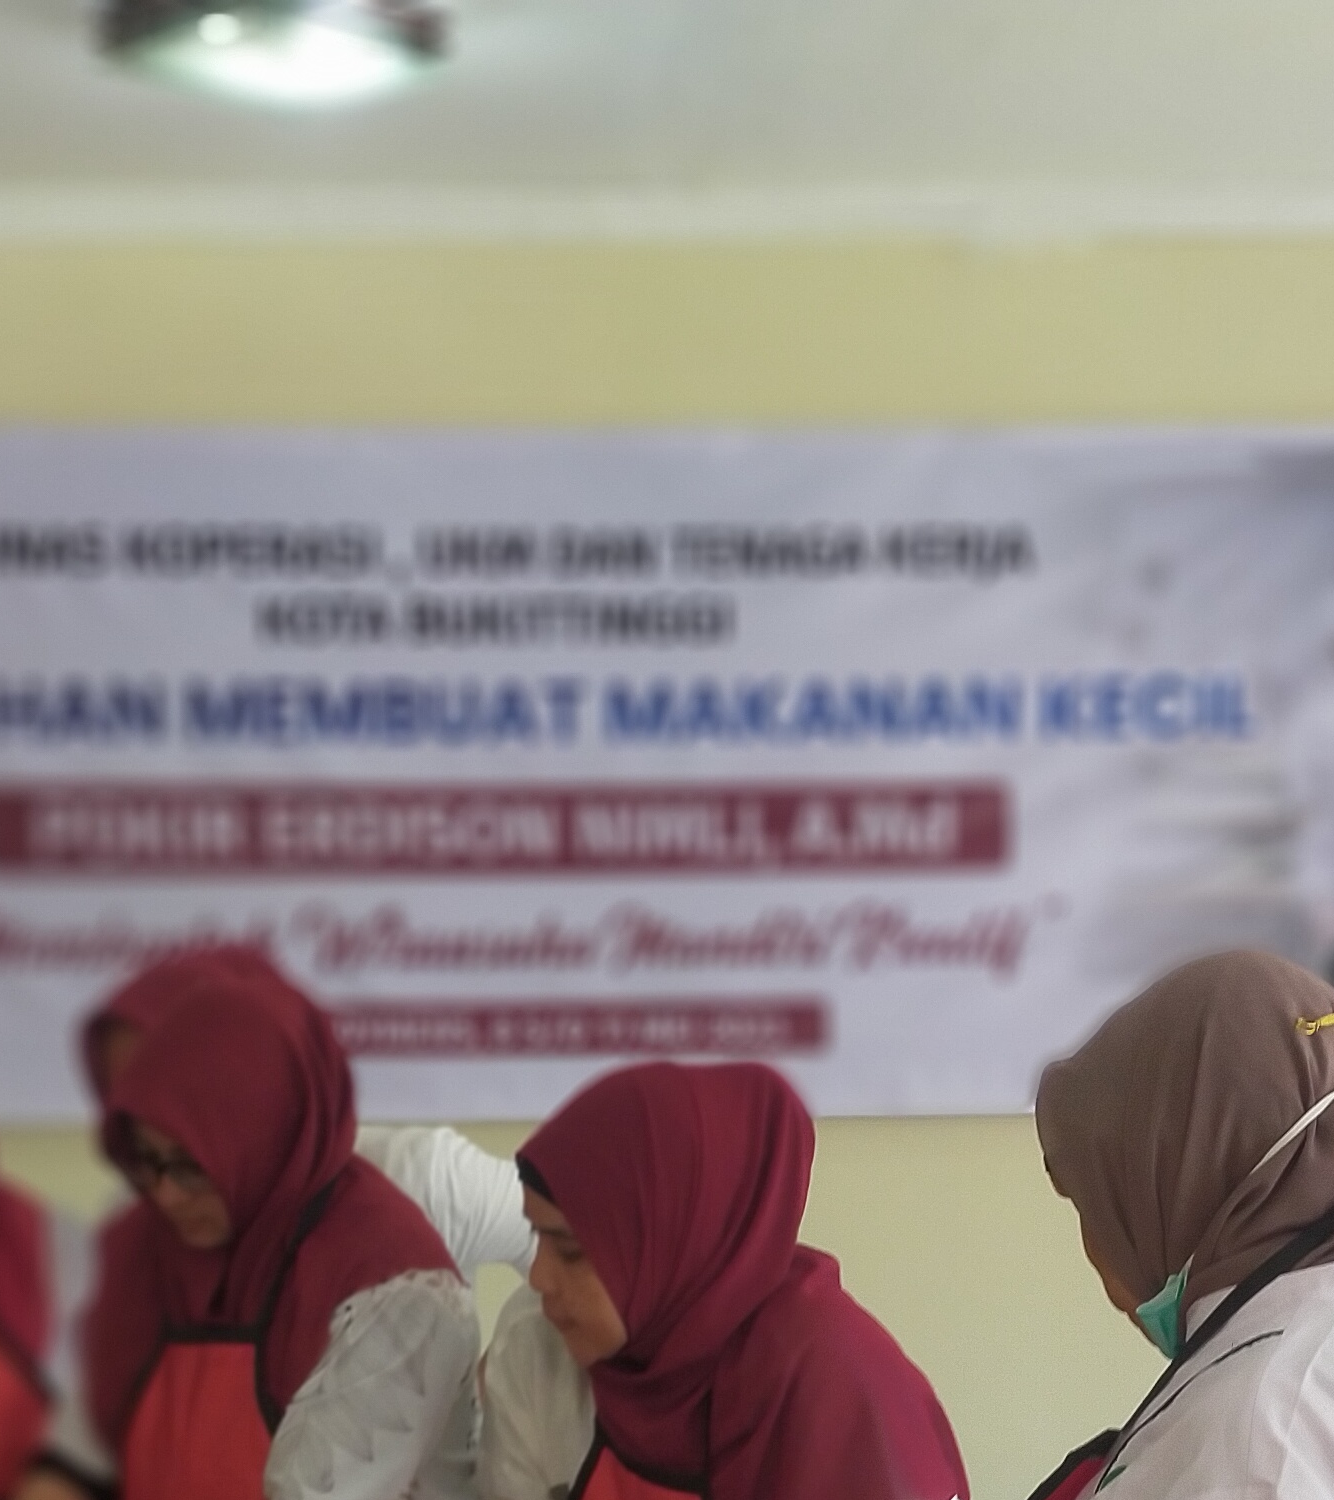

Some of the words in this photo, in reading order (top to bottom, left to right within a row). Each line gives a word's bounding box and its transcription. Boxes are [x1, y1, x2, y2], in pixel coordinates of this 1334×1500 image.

[122, 520, 378, 578] KOPERASI
[419, 522, 535, 578] UKM
[550, 522, 657, 578] DAN
[670, 522, 868, 578] TENAGA
[882, 522, 1037, 584] KERJA
[256, 592, 387, 644] KOTA
[402, 592, 733, 644] BUKITTINGGI
[183, 674, 585, 746] MEMBUAT
[601, 670, 1024, 744] MAKANAN
[1038, 668, 1257, 742] KECIL
[261, 796, 555, 858] ERDISON
